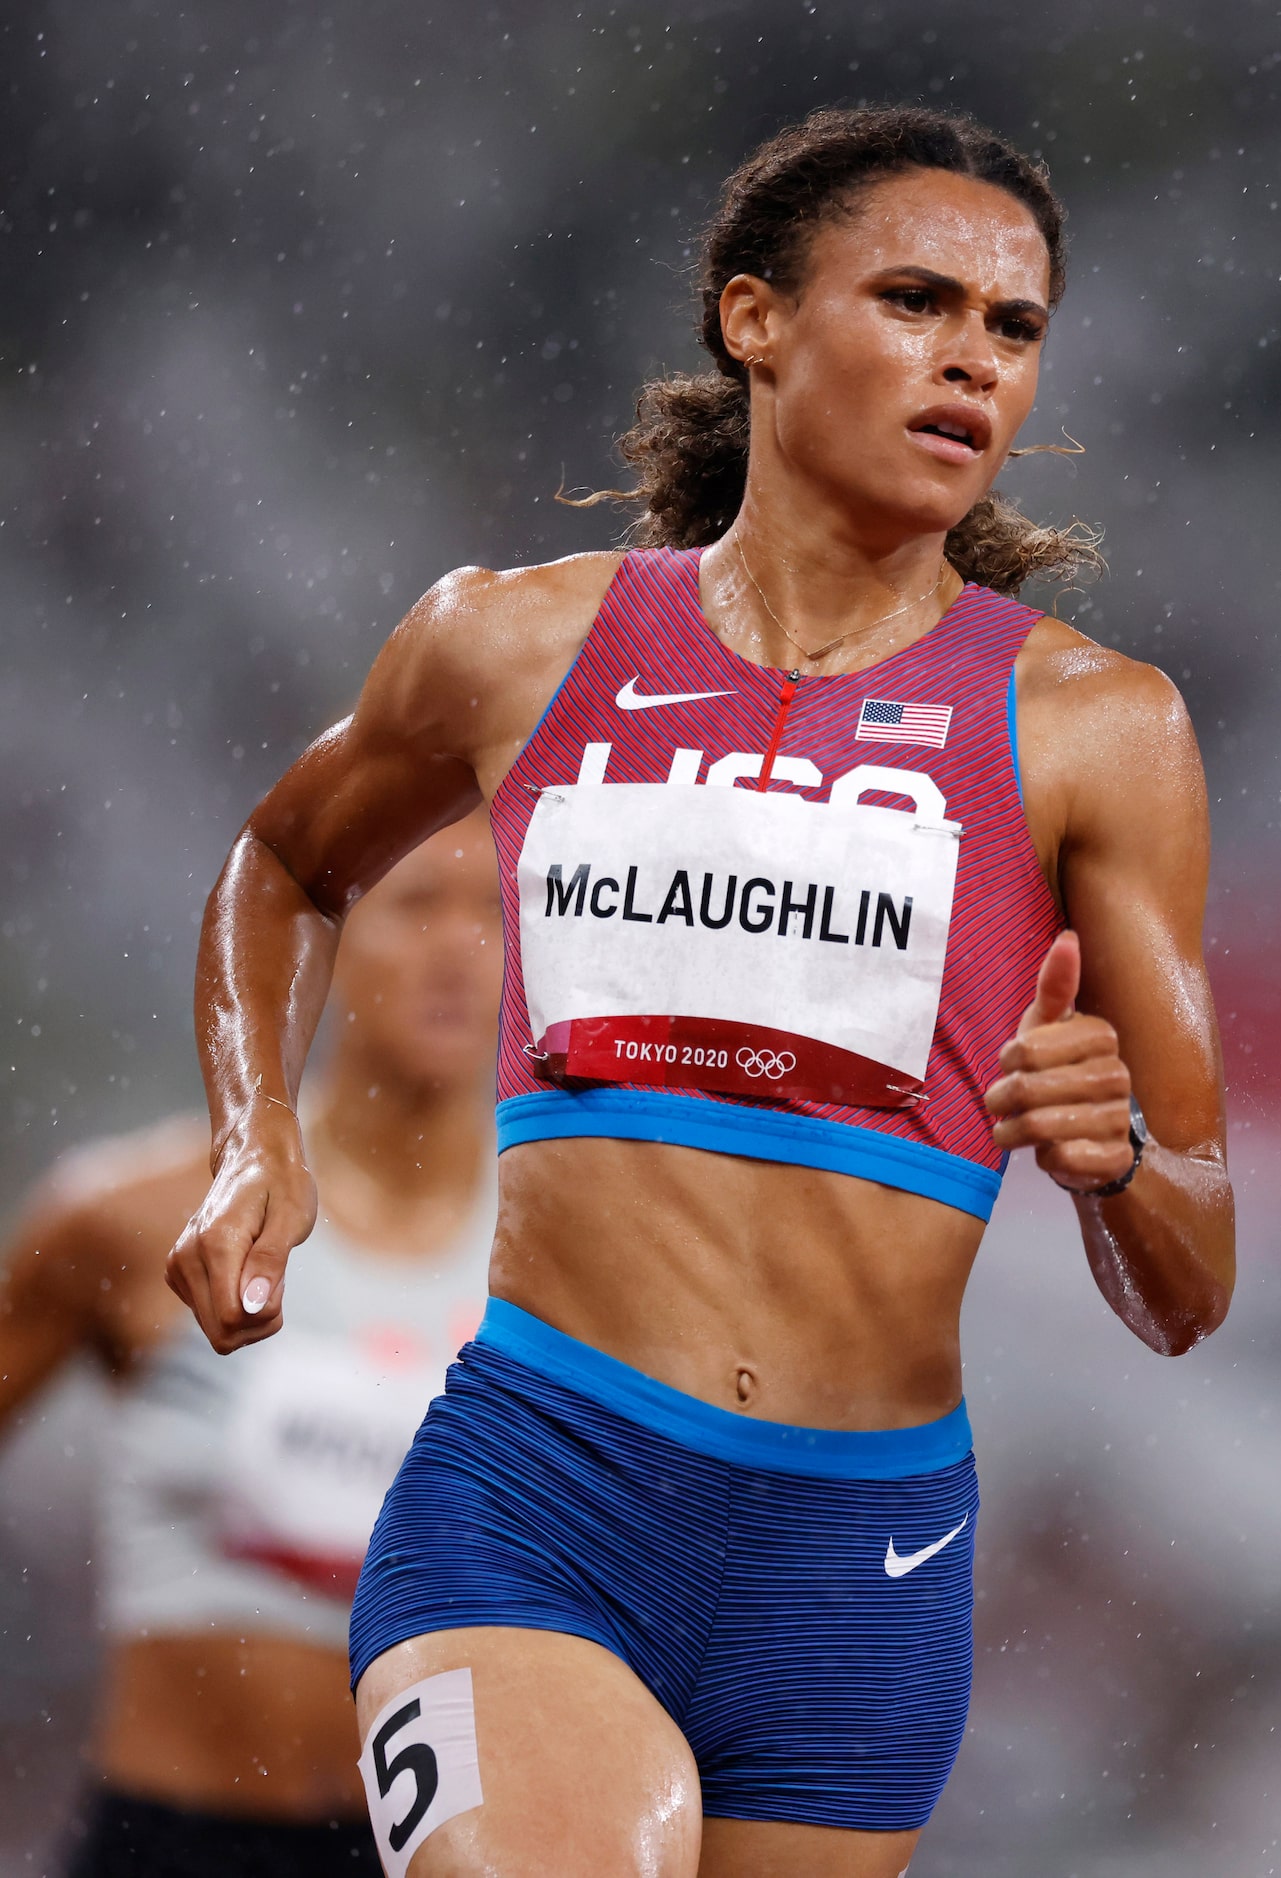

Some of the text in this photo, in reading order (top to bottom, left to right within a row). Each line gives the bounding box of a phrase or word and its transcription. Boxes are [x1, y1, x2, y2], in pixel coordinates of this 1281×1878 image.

[544, 863, 914, 951] McLAUGHLIN
[613, 1039, 729, 1069] TOKYO 2020
[371, 1696, 440, 1853] 5
